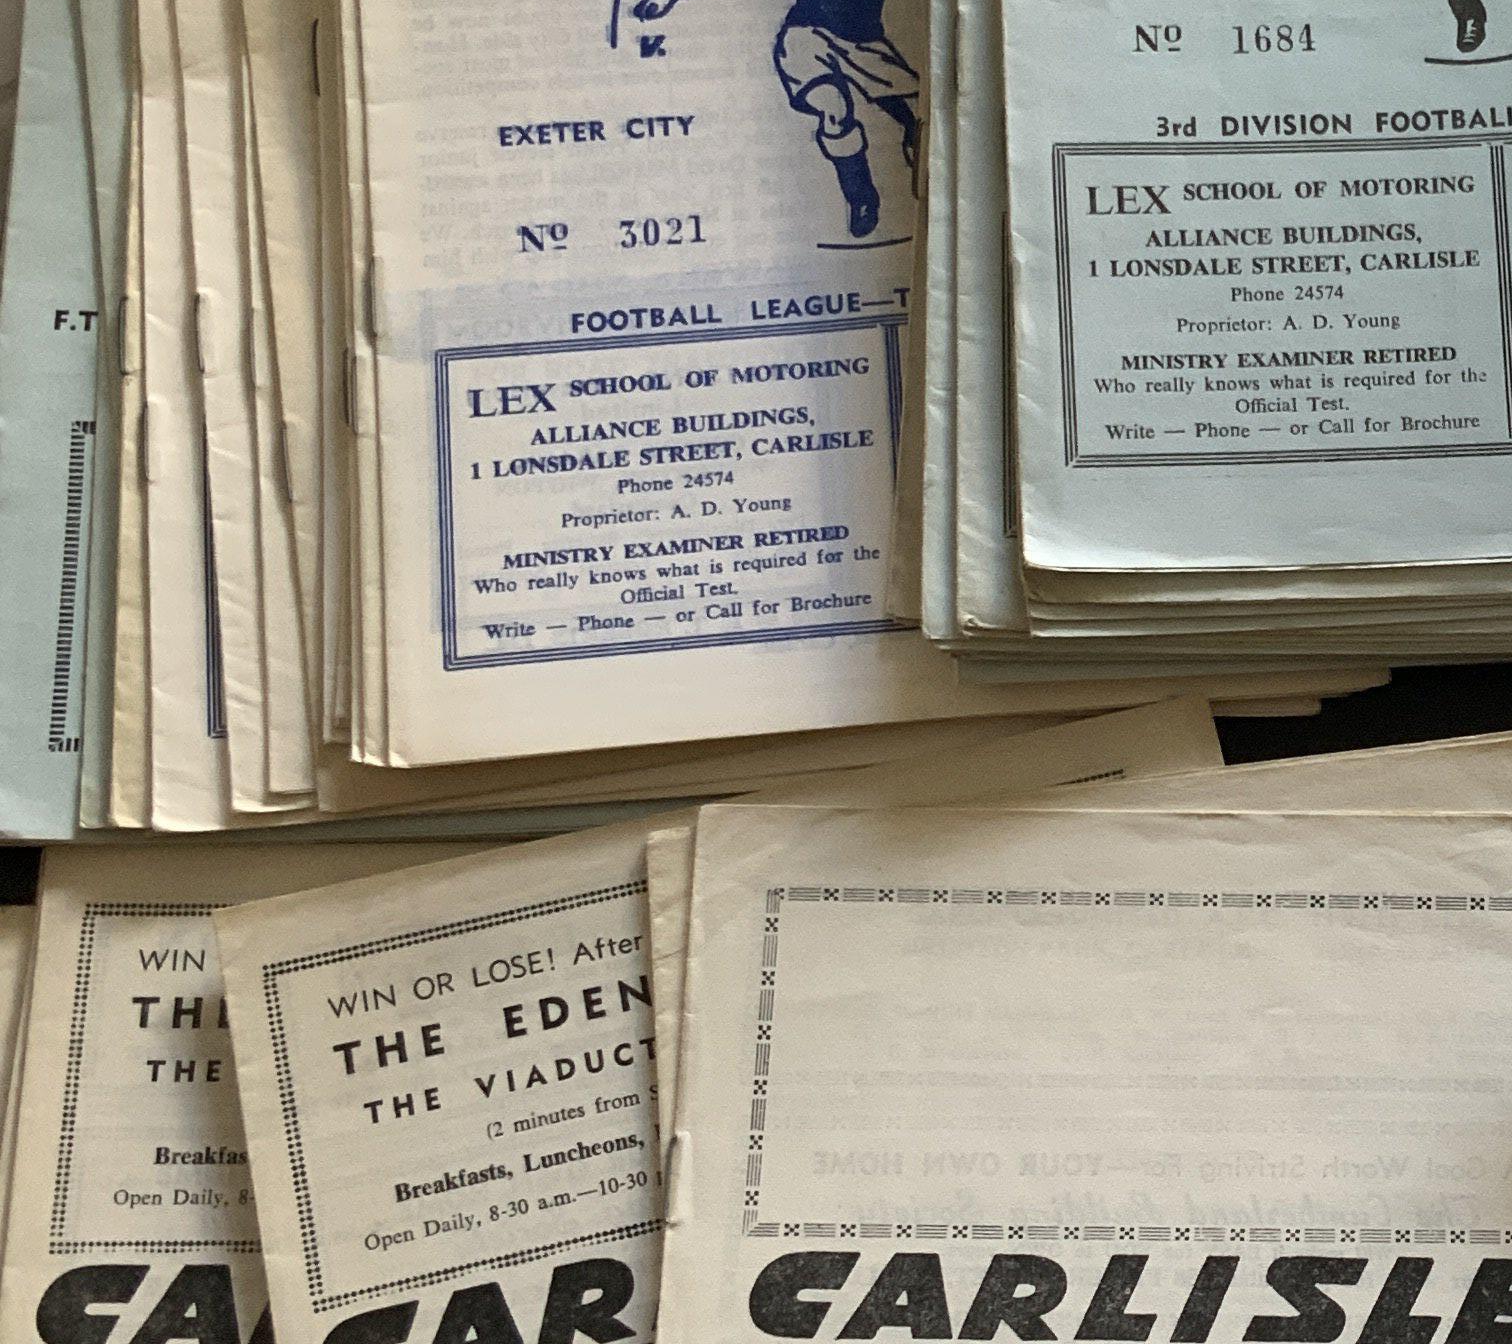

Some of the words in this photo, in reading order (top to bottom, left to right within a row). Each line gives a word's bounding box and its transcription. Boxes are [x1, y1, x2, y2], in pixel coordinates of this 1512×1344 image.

[1233, 24, 1315, 53] 1684
[498, 121, 605, 146] EXETER
[626, 116, 695, 139] CITY
[1222, 114, 1351, 136] DIVISION
[620, 215, 706, 248] 3021
[468, 384, 556, 418] LEX
[570, 374, 671, 397] SCHOOL
[732, 357, 869, 384] MOTORING
[531, 419, 661, 445] ALLIANCE
[673, 407, 815, 433] BUILDINGS,
[493, 450, 630, 477] LONSDALE
[640, 441, 742, 465] STREET,
[751, 430, 874, 456] CARLISLE
[618, 479, 673, 494] Phone
[683, 471, 734, 488] 24574
[328, 985, 396, 1018] WIN
[413, 973, 454, 1000] OR
[472, 948, 555, 987] LOSE!
[333, 1023, 444, 1075] THE
[514, 1106, 585, 1132] minutes
[595, 1094, 640, 1113] from
[395, 1164, 513, 1202] Breakfasts,
[523, 1135, 648, 1172] Luncheons,
